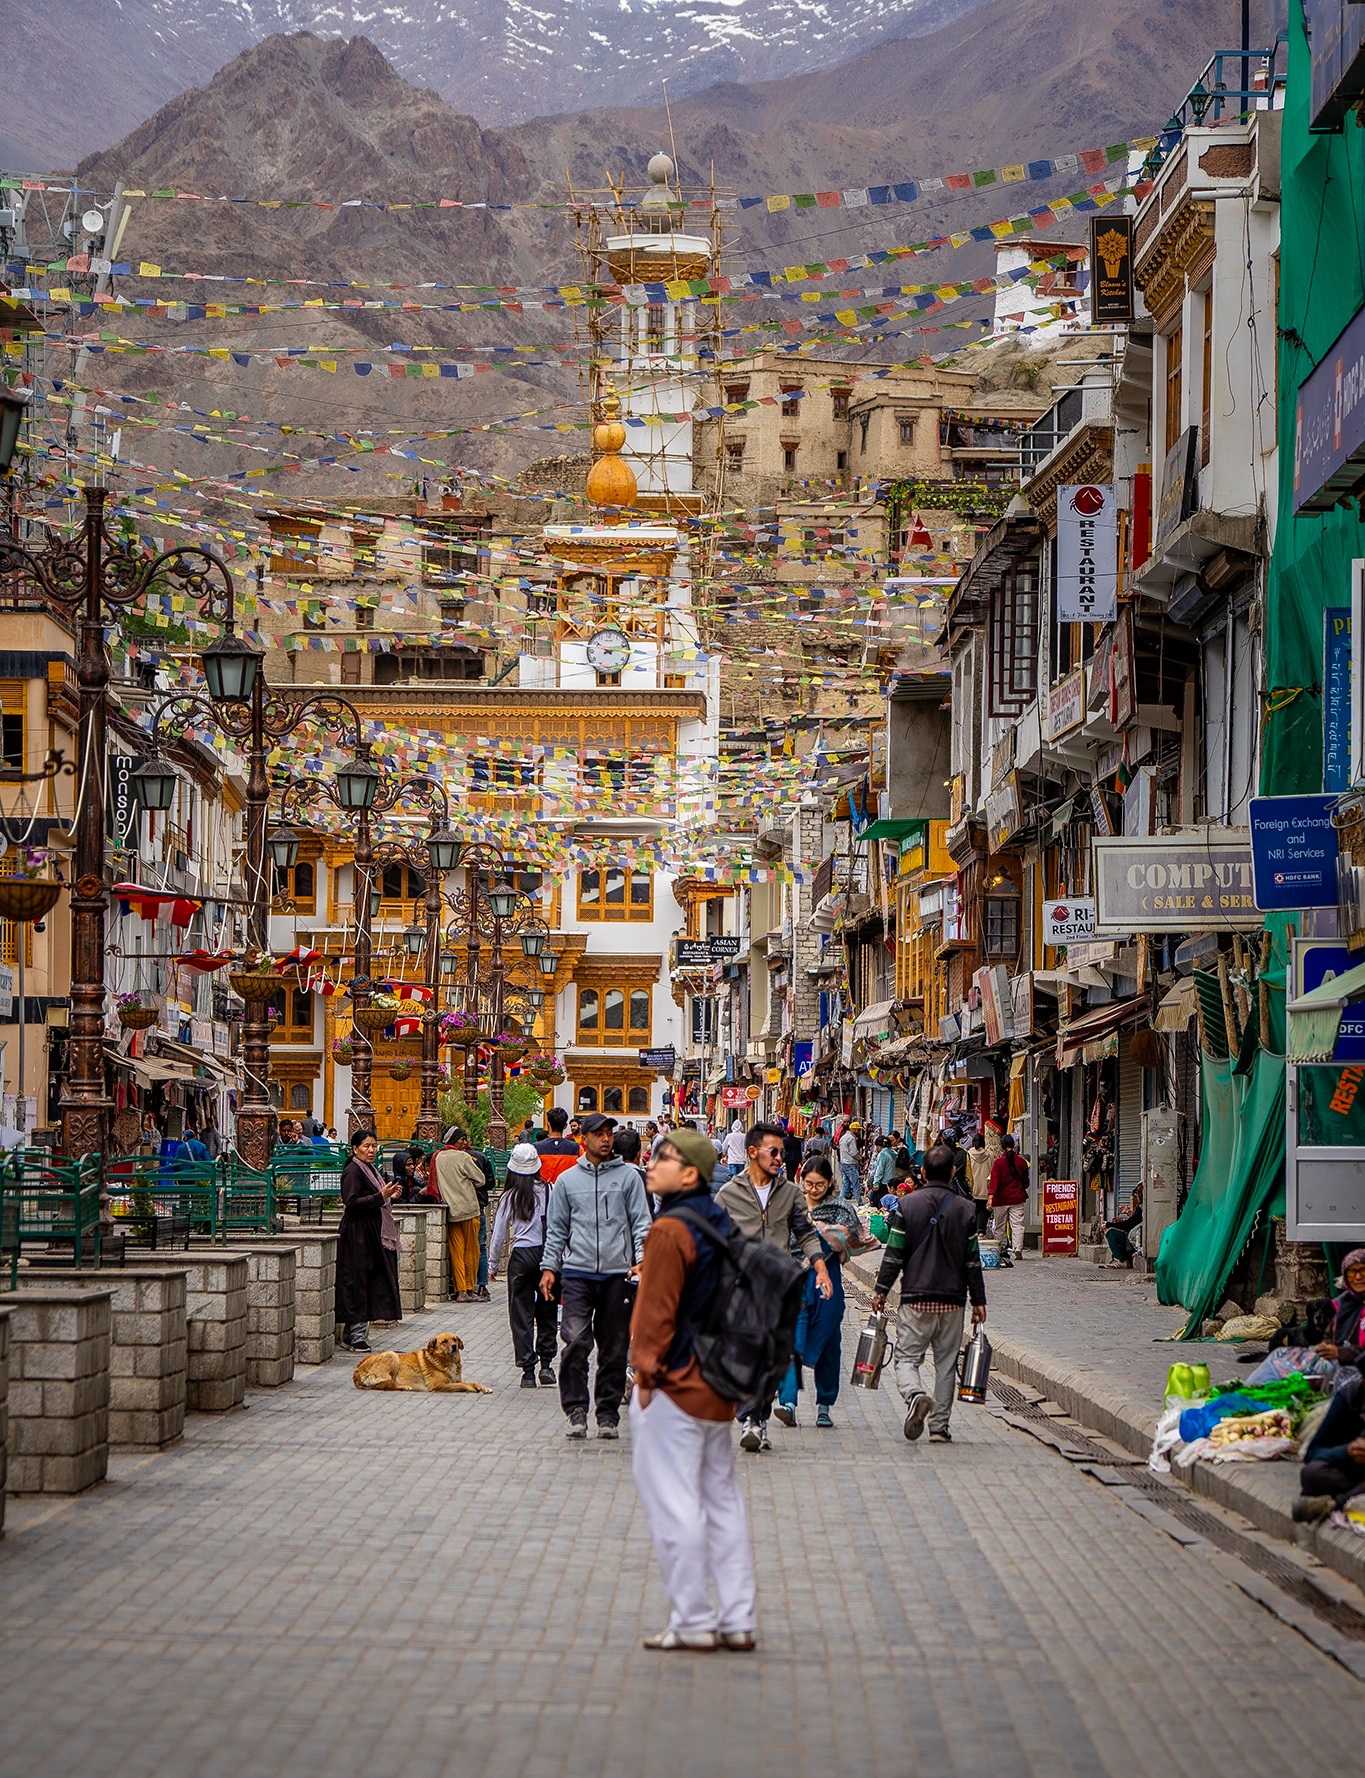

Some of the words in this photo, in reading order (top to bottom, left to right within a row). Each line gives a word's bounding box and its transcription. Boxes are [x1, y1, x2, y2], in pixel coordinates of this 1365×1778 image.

[1099, 280, 1127, 288] Bloom's
[1100, 288, 1126, 296] Kitchen
[1079, 520, 1096, 613] RESTAURANT
[116, 756, 132, 838] monsoo
[1254, 819, 1289, 831] Foreign
[1286, 832, 1306, 844] and
[1268, 850, 1284, 860] NRI
[1287, 848, 1325, 859] Services
[1126, 862, 1253, 890] COMPUT
[1153, 895, 1196, 909] SALE
[1201, 895, 1214, 909] &
[1219, 894, 1254, 908] SER
[1075, 907, 1094, 921] RI-
[1052, 922, 1095, 935] RESTAU
[1046, 1183, 1076, 1194] FRIENDS
[1045, 1200, 1078, 1213] RESTAURANT
[1045, 1214, 1074, 1224] TIBETAN
[1054, 1223, 1074, 1231] CHINES
